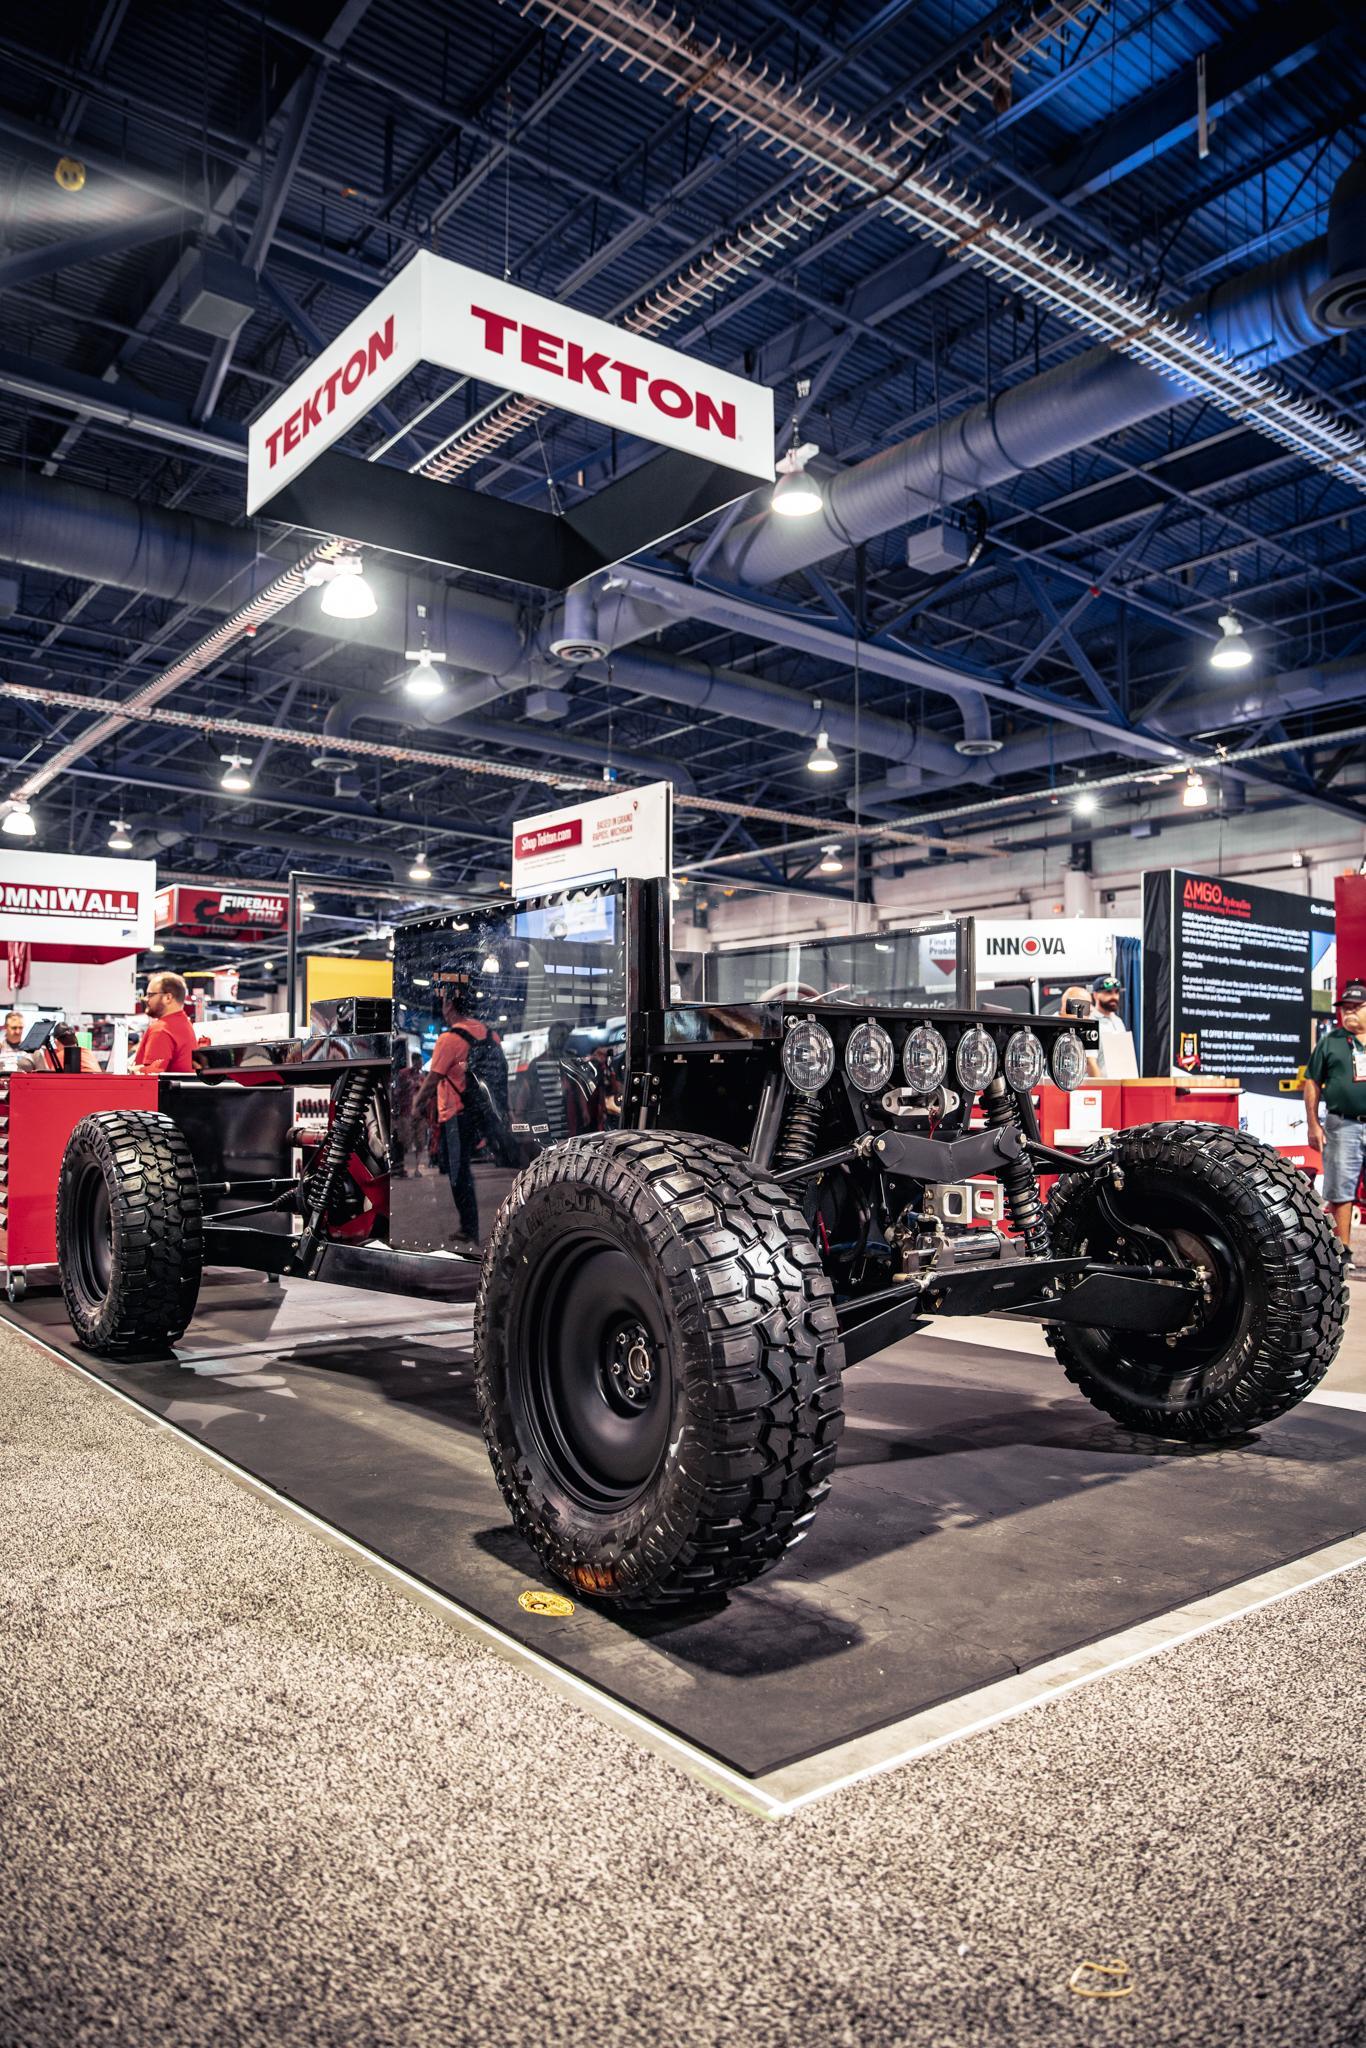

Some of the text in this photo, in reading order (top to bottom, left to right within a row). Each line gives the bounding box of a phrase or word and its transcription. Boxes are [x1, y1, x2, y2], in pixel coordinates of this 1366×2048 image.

[469, 304, 736, 440] TEKTON
[265, 314, 395, 469] TEKTON
[521, 836, 537, 851] Shop
[537, 828, 572, 847] Tekton.com
[1183, 880, 1223, 905] AMGO
[219, 894, 284, 913] FIREBALL
[1310, 903, 1320, 915] Our
[247, 909, 280, 923] TOOL
[986, 936, 1066, 956] INNOVA
